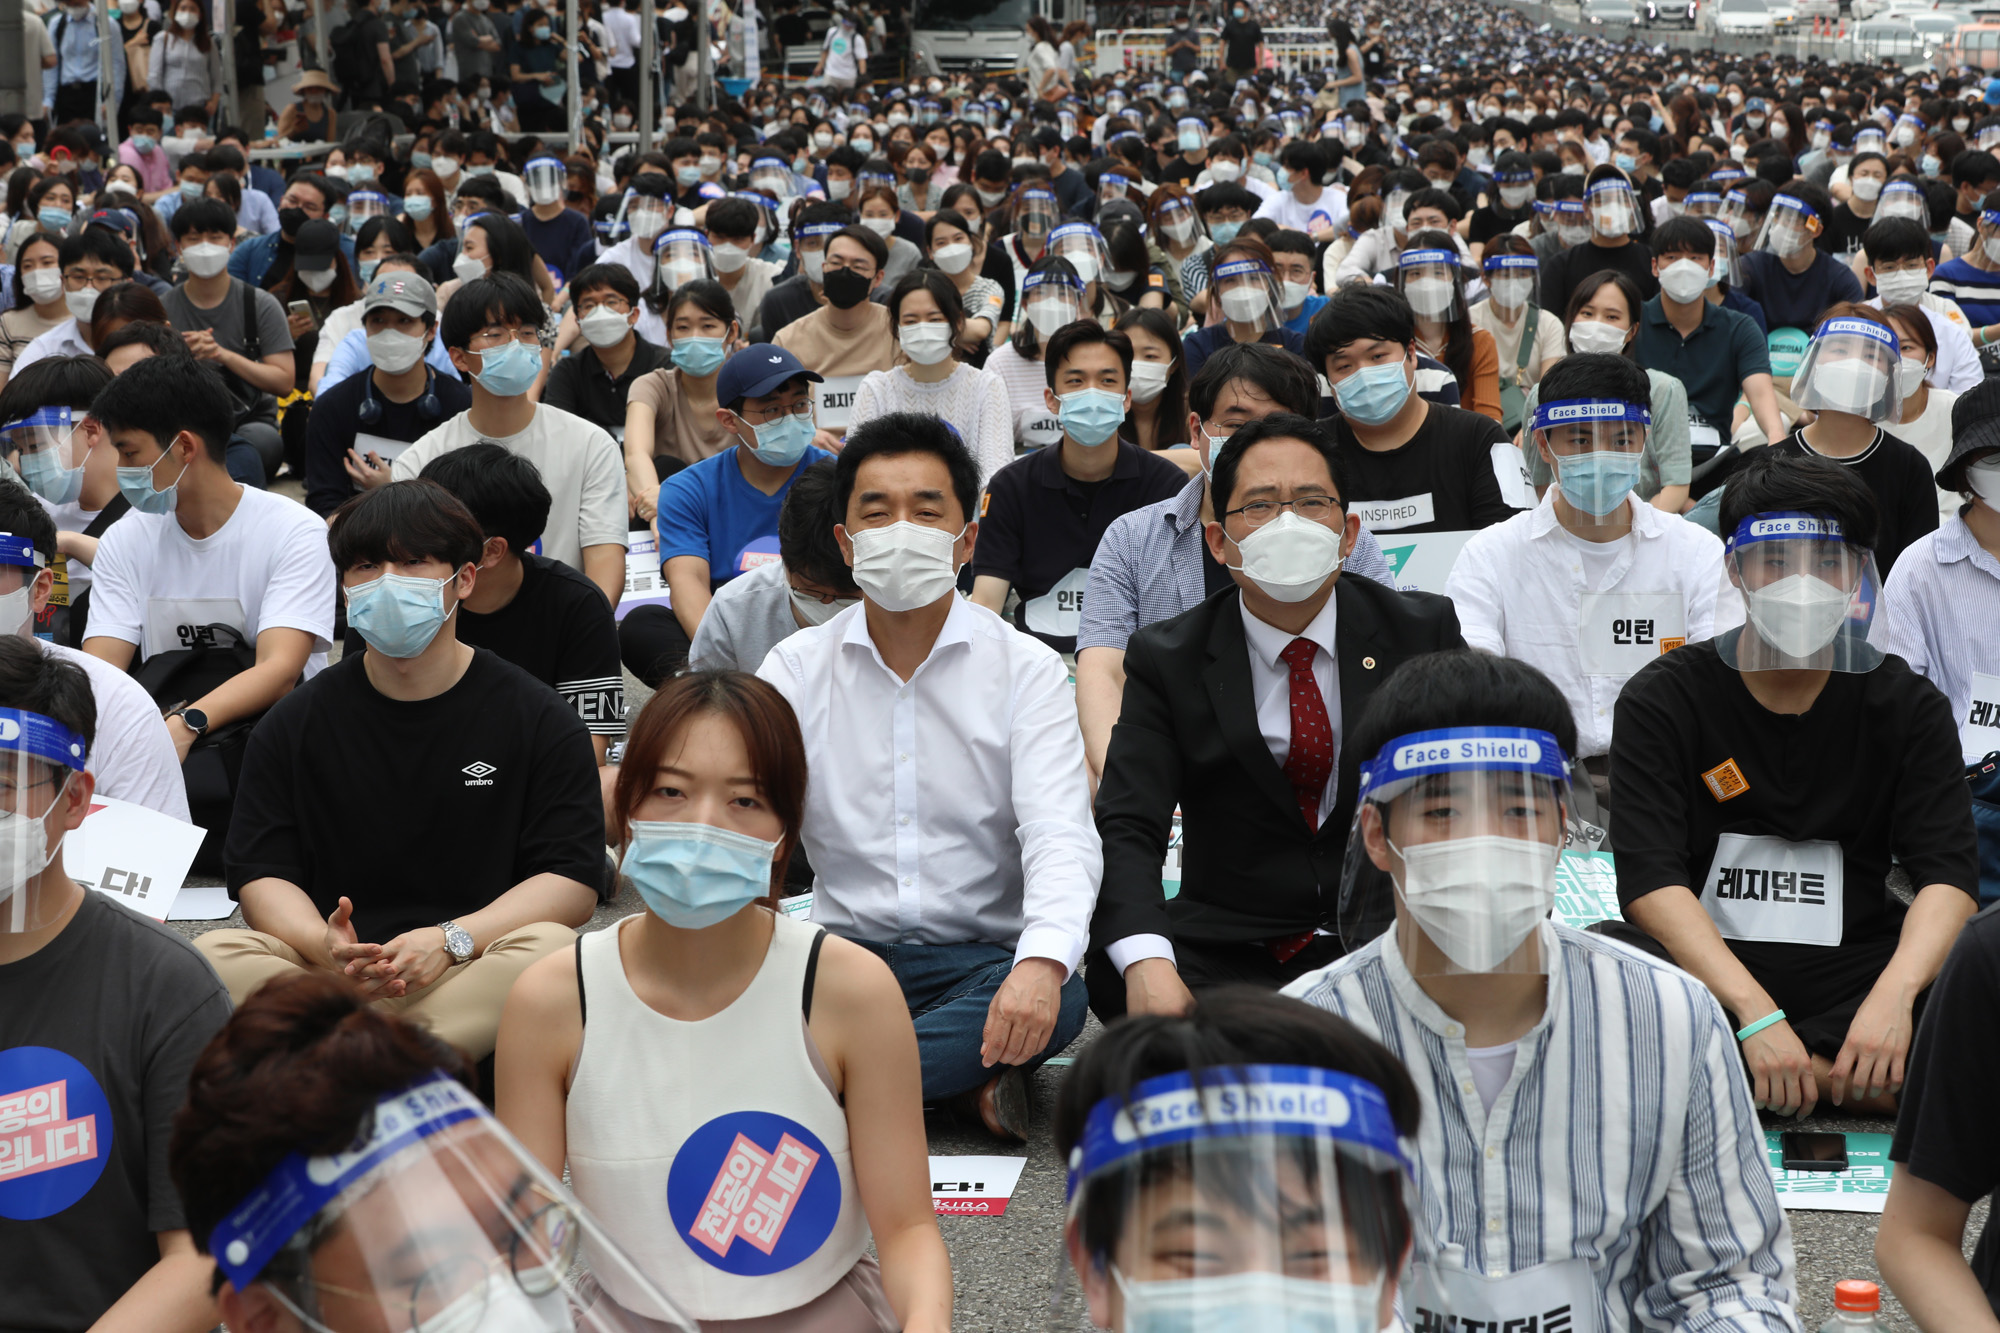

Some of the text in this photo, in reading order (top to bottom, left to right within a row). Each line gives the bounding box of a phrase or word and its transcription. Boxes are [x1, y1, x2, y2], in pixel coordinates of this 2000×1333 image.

[1834, 322, 1888, 340] Face Shield
[823, 393, 857, 410] 레지
[1553, 405, 1618, 418] Face Shield
[1361, 504, 1417, 522] INSPIRED
[1758, 519, 1842, 534] Face Shield
[1612, 619, 1654, 645] 인턴
[1405, 745, 1450, 765] Face
[1461, 742, 1528, 759] Shield
[464, 778, 494, 787] umbro
[1716, 866, 1826, 906] 레지던트
[1219, 1091, 1328, 1118] Shield
[697, 1141, 768, 1247] 전공의
[742, 1142, 812, 1246] 입니다
